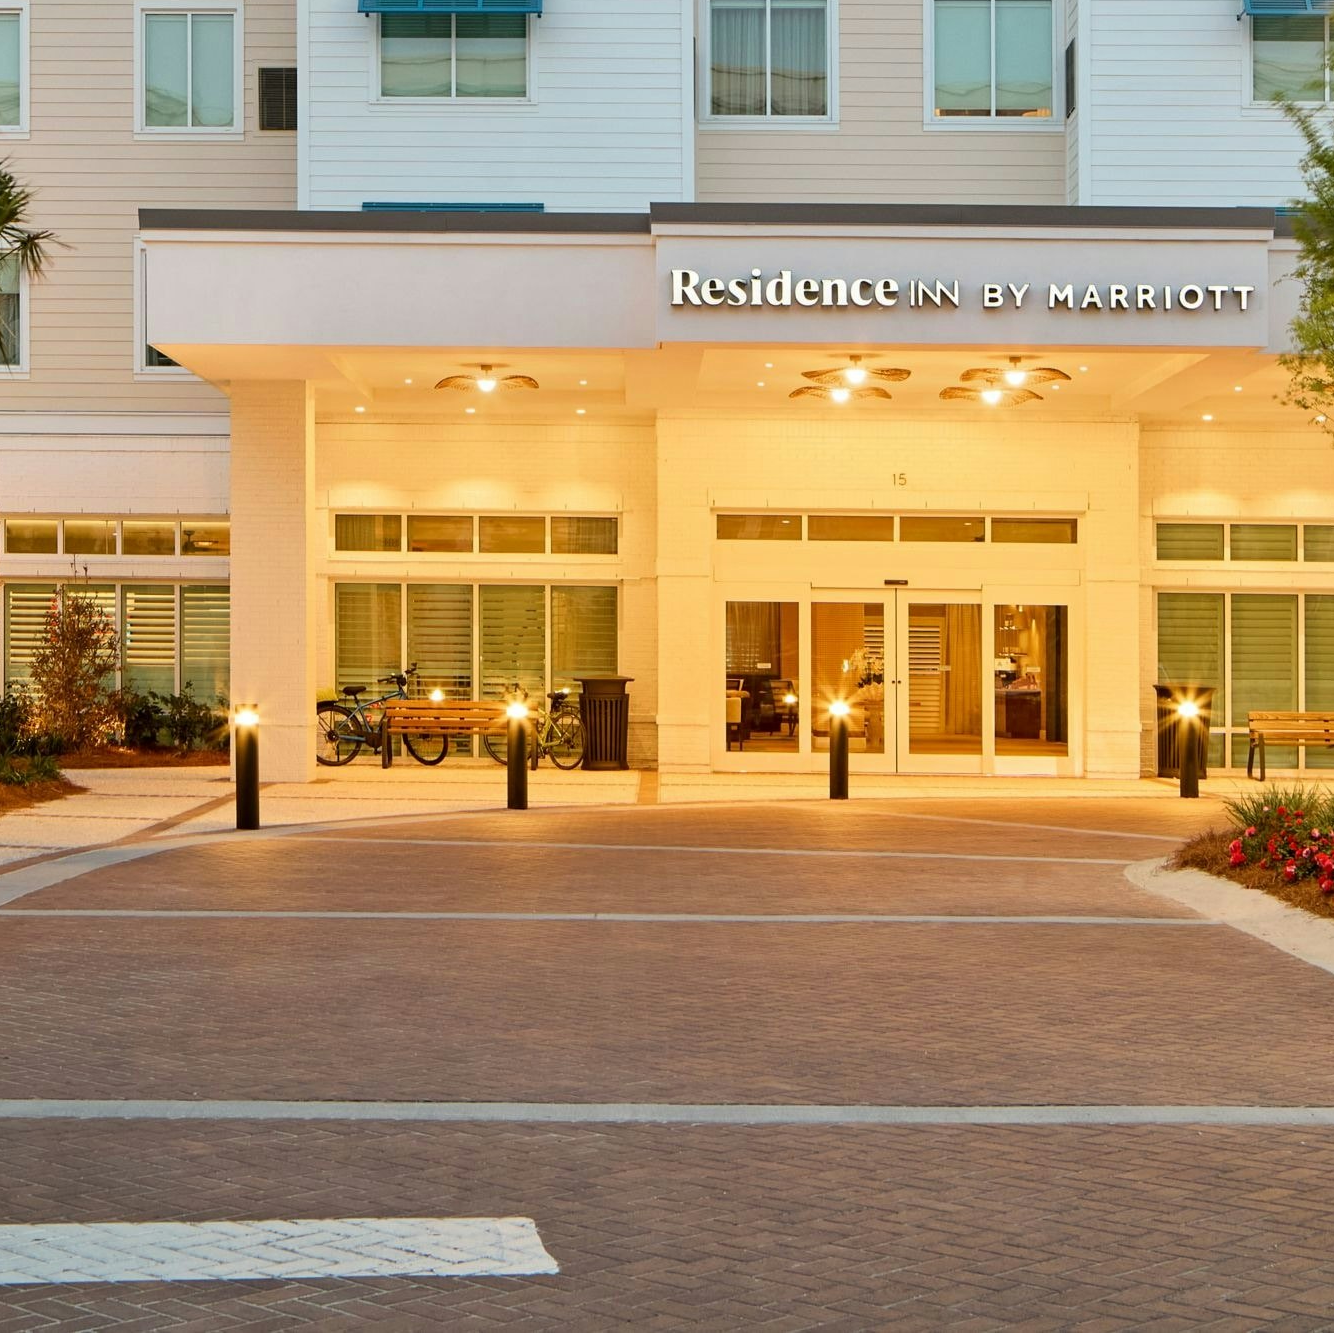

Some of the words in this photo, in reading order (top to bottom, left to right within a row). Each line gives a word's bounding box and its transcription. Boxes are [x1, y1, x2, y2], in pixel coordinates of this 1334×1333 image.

[670, 268, 899, 306] Residence
[909, 278, 959, 308] INN
[983, 282, 1030, 308] BY
[1048, 283, 1255, 311] MARRIOTT
[892, 472, 907, 486] 15
